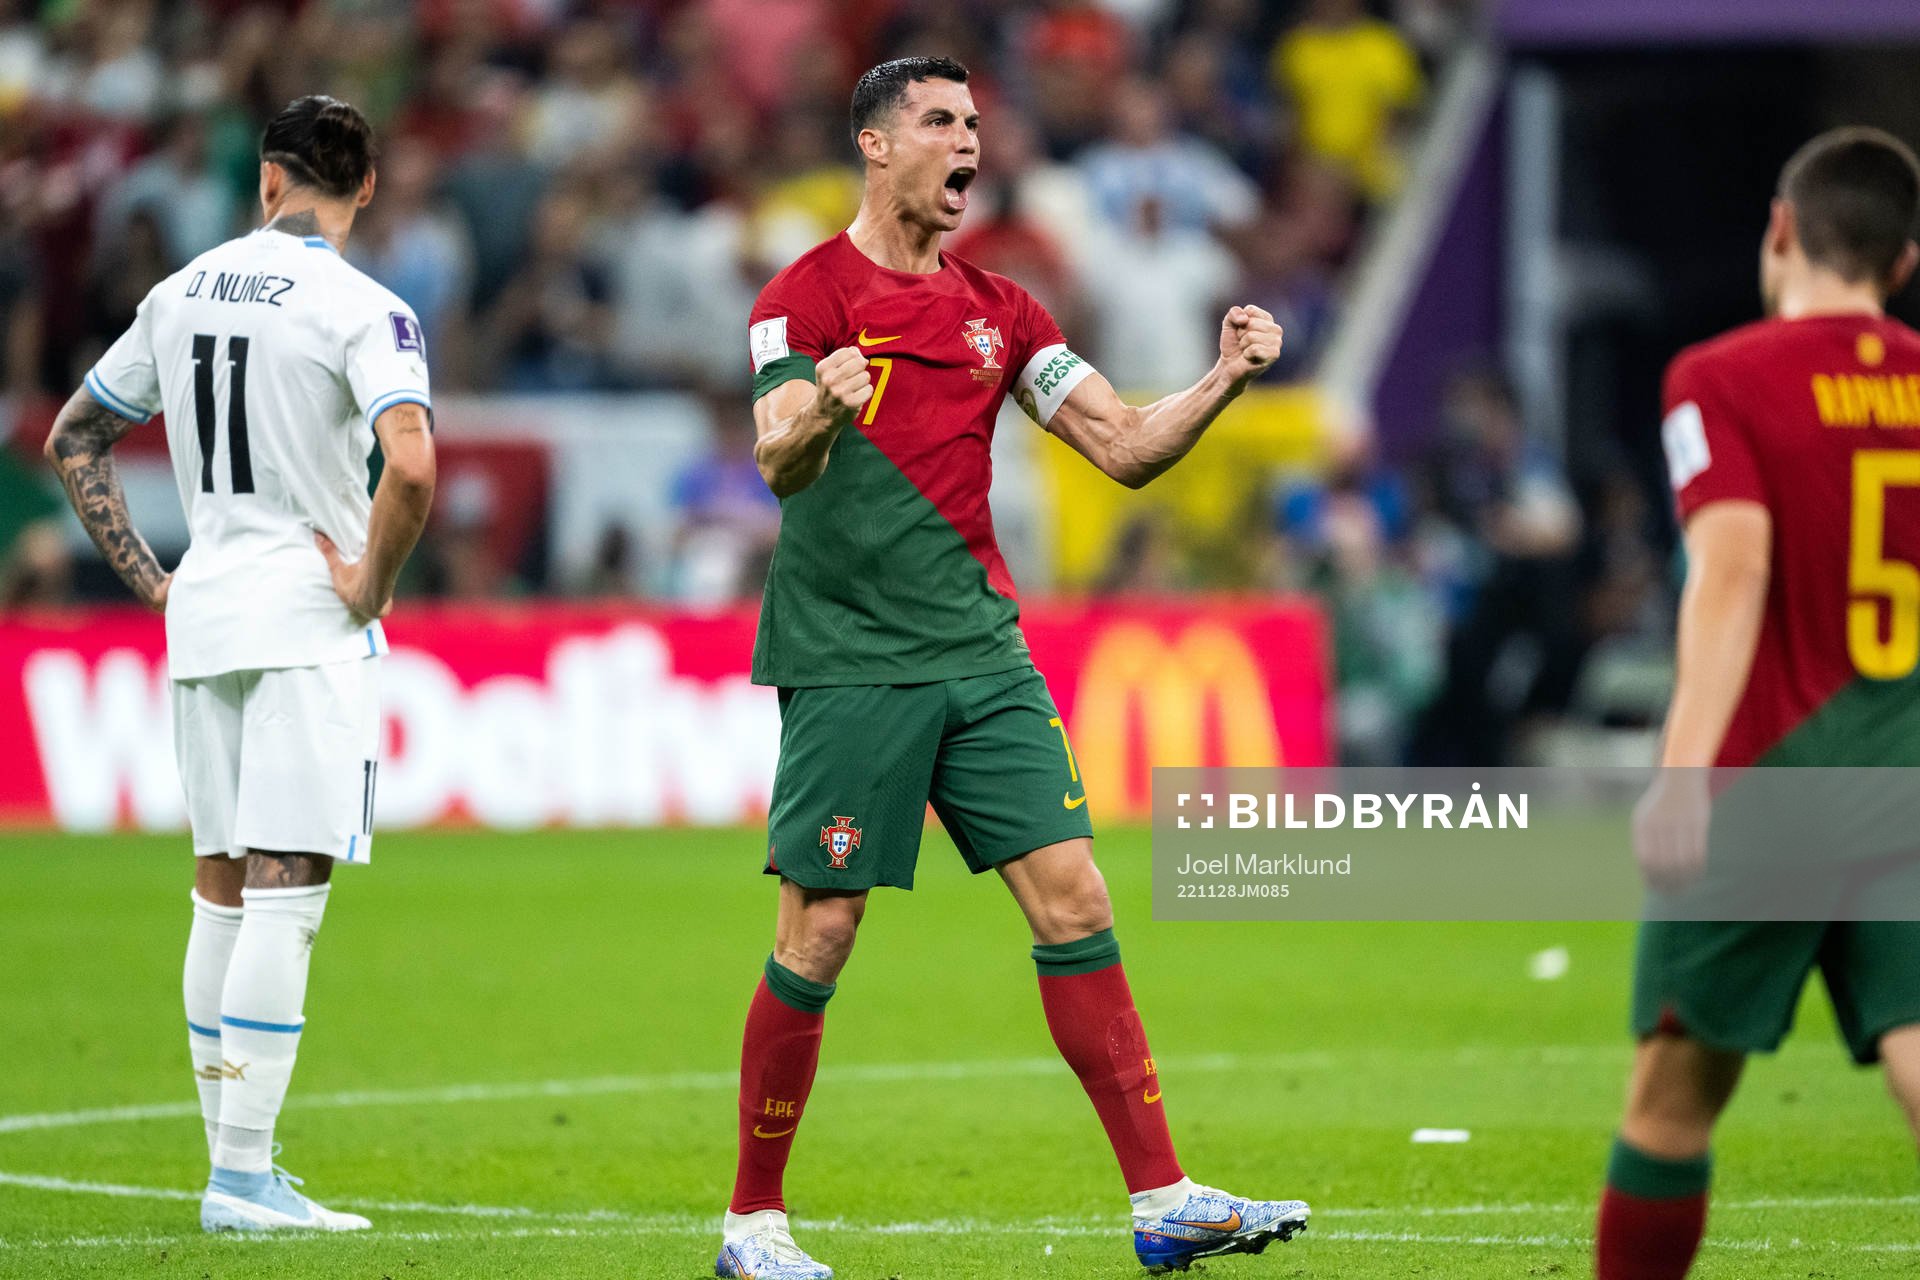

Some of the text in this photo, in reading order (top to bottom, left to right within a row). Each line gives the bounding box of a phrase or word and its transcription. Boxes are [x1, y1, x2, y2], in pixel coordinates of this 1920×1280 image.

[186, 271, 206, 298] D.
[862, 358, 893, 425] 7
[1034, 356, 1063, 388] SAVE
[192, 333, 255, 494] 11
[1846, 450, 1920, 681] 5
[1049, 717, 1079, 782] 7
[363, 760, 377, 835] 11
